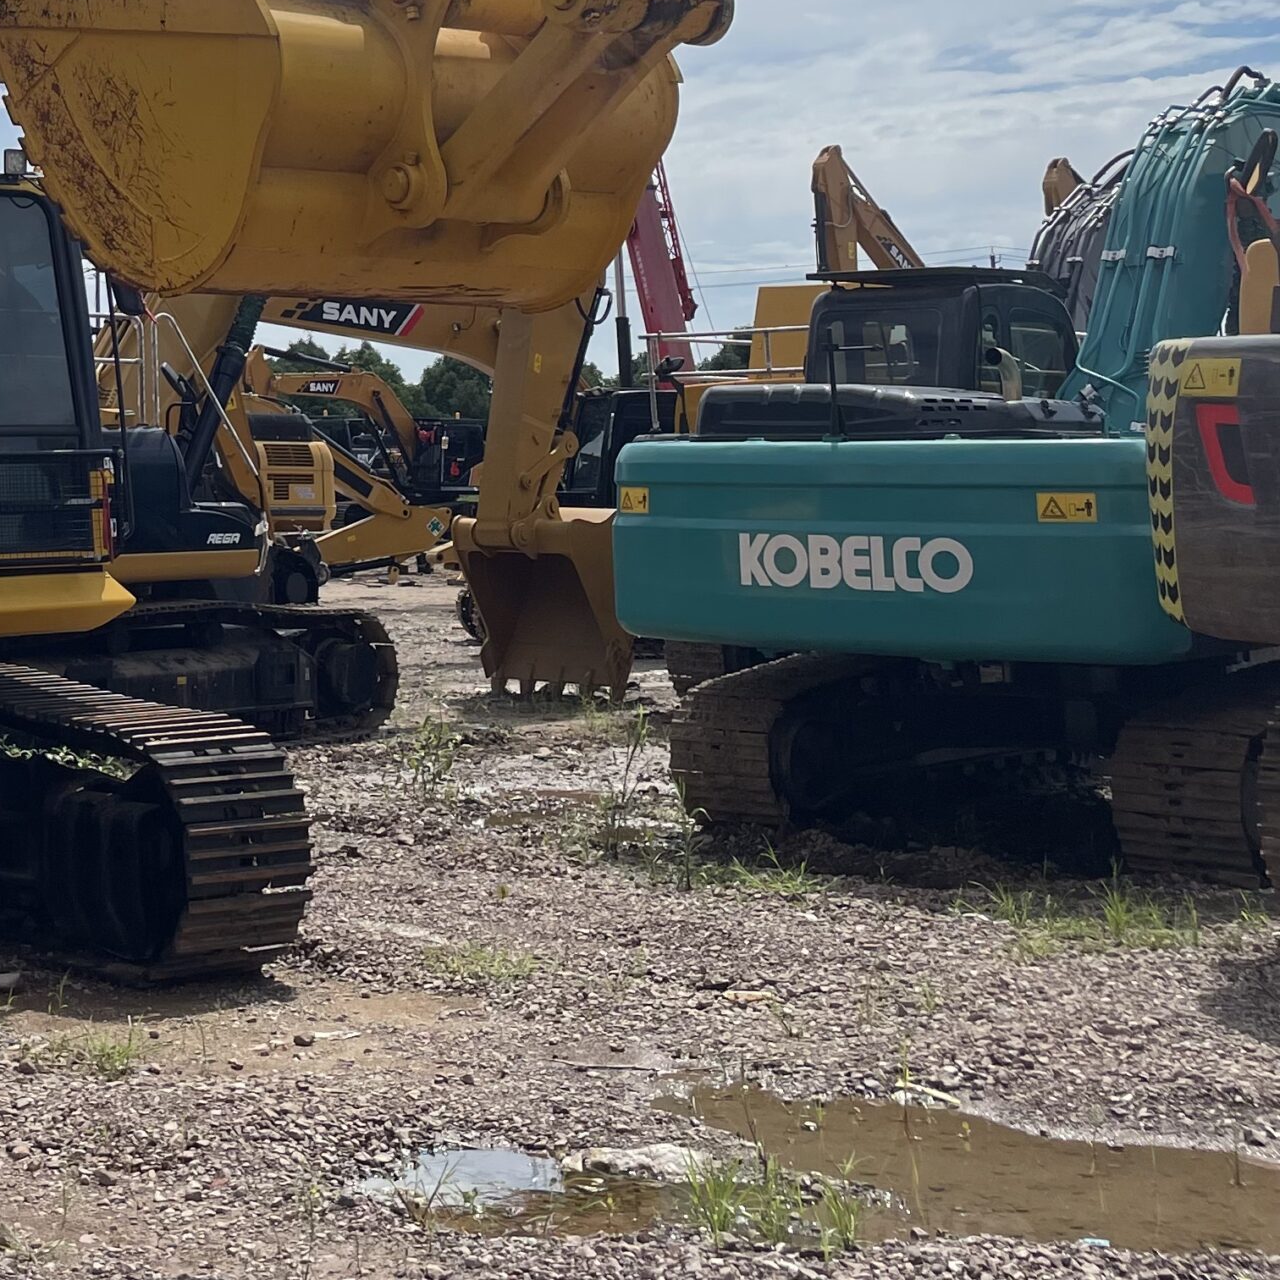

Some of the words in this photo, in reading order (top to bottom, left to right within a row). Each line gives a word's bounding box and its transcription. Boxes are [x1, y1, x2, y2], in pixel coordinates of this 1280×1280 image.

[890, 245, 912, 269] SAN
[322, 301, 397, 329] SANY
[309, 382, 335, 393] SANY
[739, 533, 974, 593] KOBELCO
